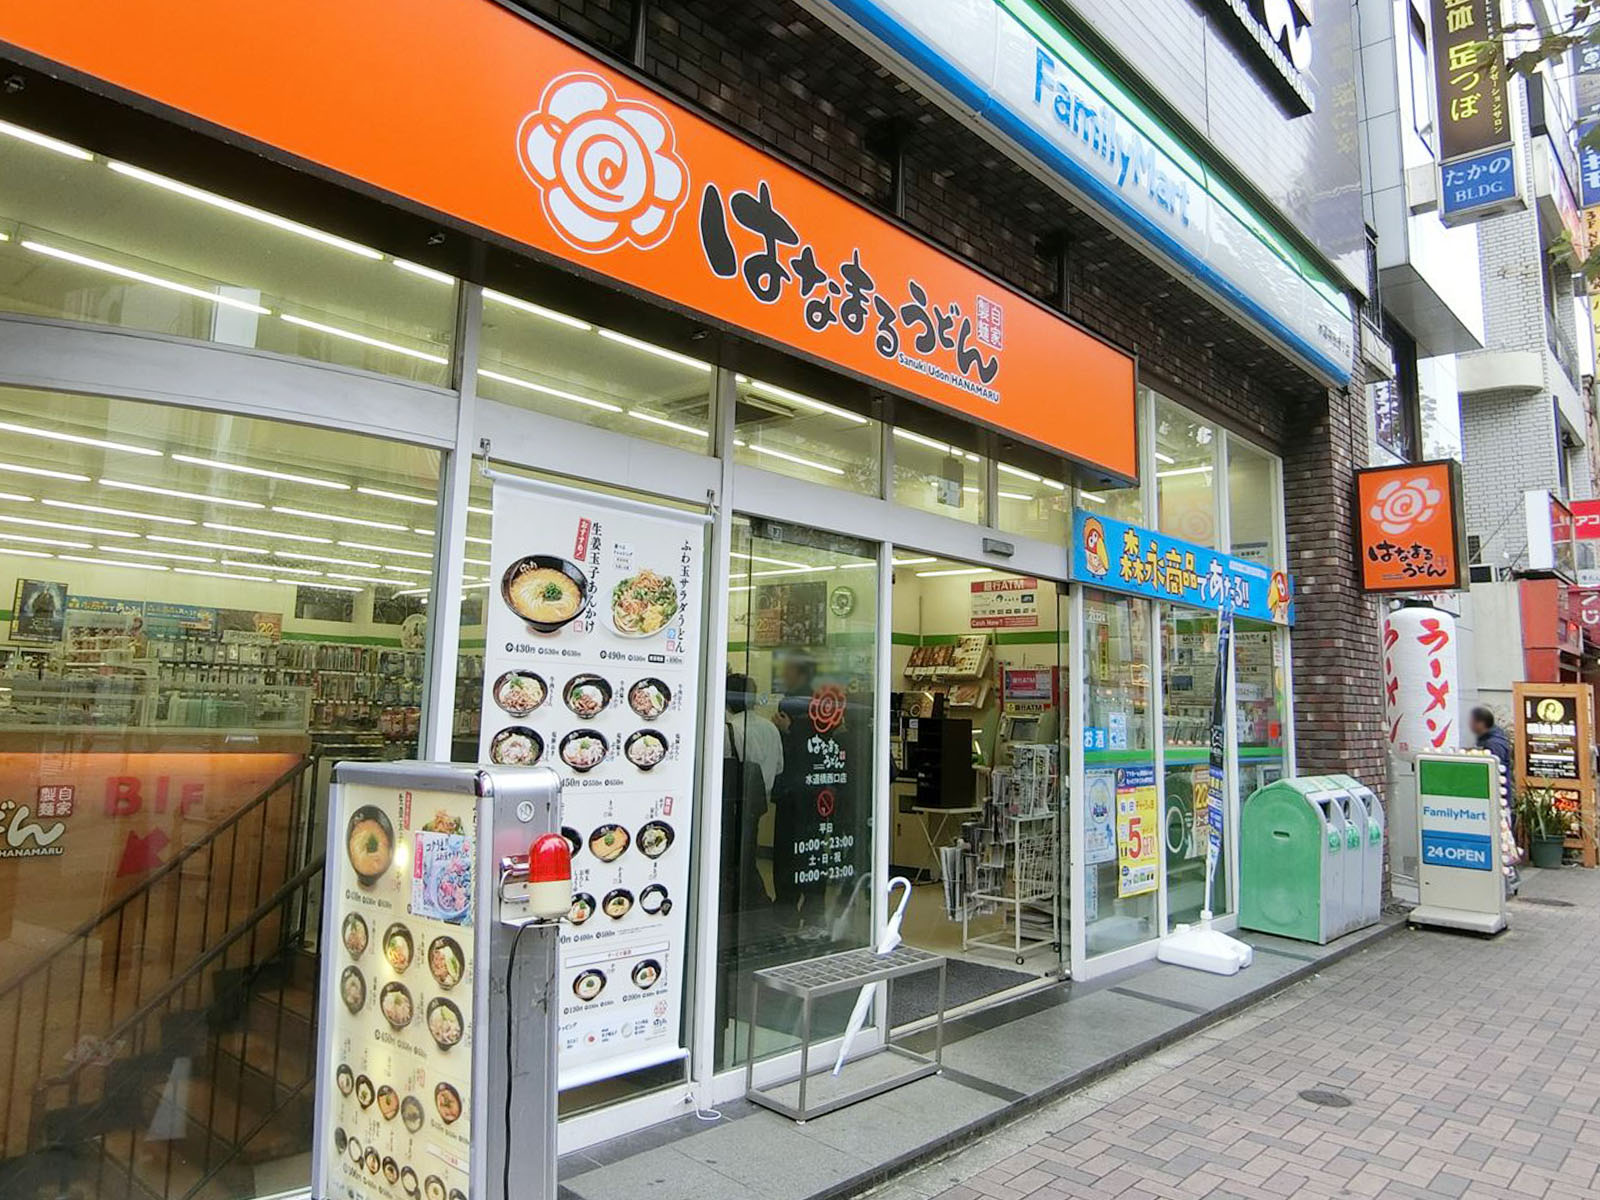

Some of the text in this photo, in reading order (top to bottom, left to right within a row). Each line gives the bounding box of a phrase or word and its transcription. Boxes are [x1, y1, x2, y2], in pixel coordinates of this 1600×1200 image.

[1448, 40, 1481, 121] 足つぼ
[1033, 46, 1190, 228] FamilyMart
[1446, 156, 1511, 187] たかの
[1455, 180, 1503, 203] BLDG
[699, 180, 998, 385] はなまるうどん
[899, 352, 1000, 403] Sanuki Udon HANAMARU
[1368, 540, 1434, 563] はなまる
[1402, 562, 1447, 578] うどん
[675, 539, 692, 653] ふわ玉サラダうどん
[1416, 617, 1453, 749] ラーメン
[819, 822, 833, 834] 平日
[1423, 806, 1487, 822] FamilyMart
[1426, 845, 1486, 864] 24 OPEN
